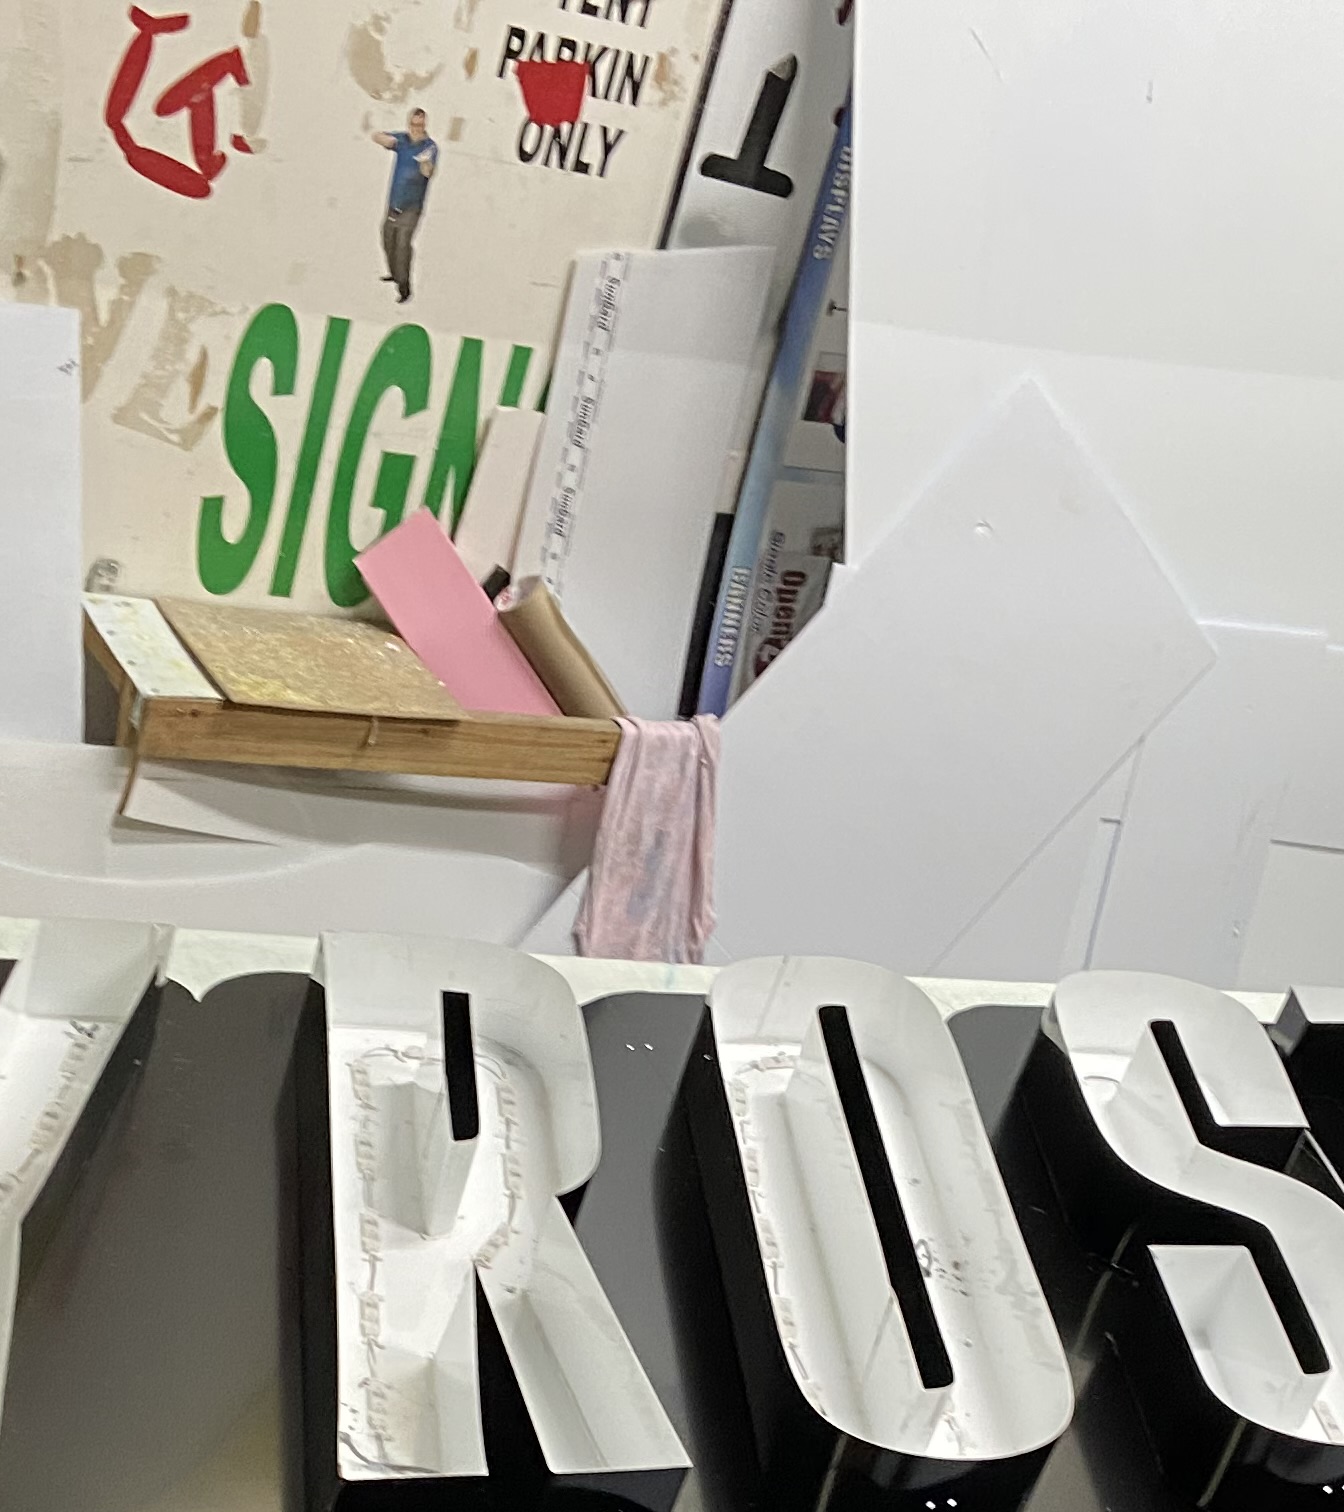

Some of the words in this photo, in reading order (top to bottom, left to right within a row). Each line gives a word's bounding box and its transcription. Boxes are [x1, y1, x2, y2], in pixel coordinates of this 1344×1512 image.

[517, 118, 629, 178] ONLY
[197, 302, 552, 608] SIGN
[714, 565, 752, 668] BANNERS
